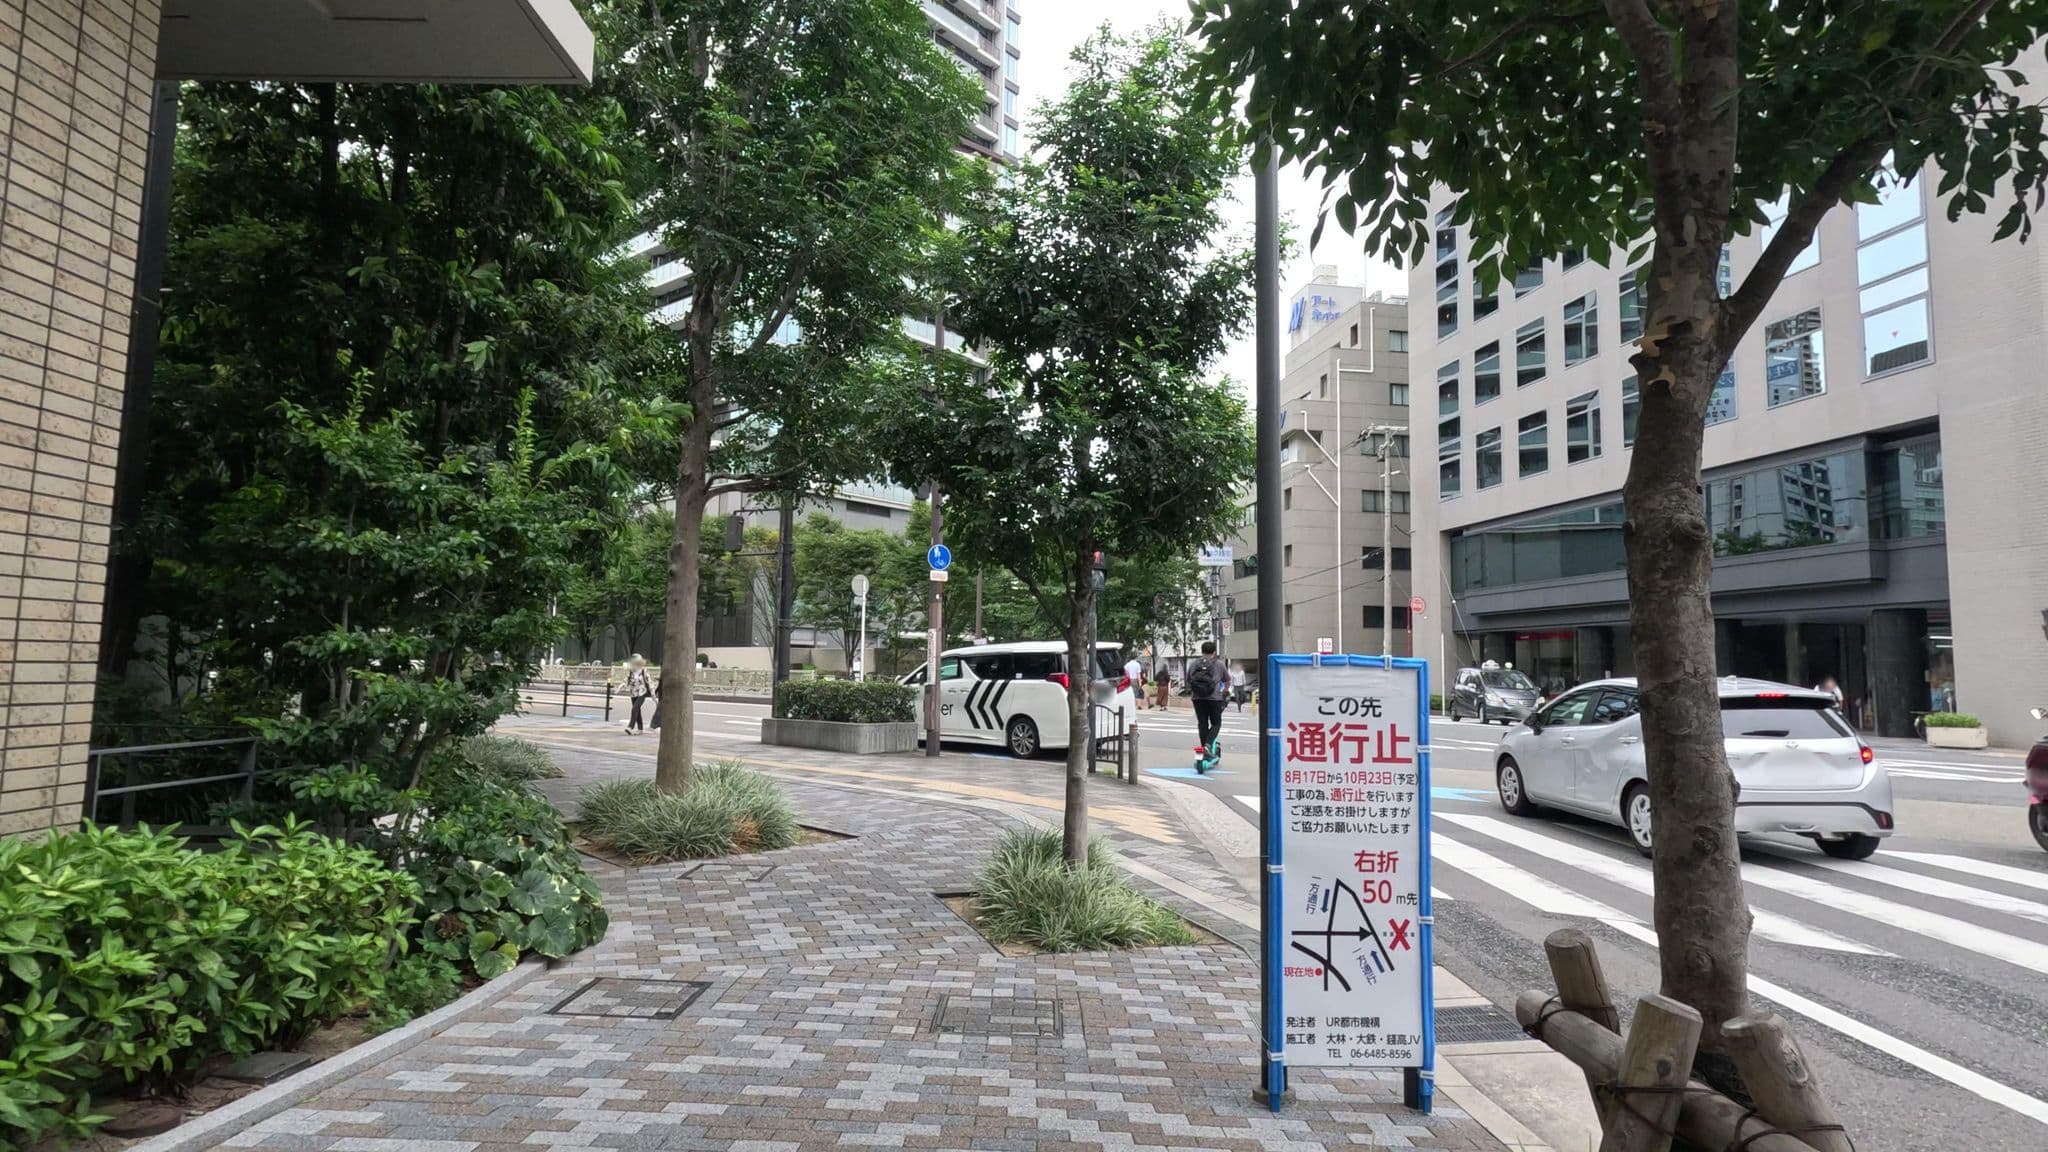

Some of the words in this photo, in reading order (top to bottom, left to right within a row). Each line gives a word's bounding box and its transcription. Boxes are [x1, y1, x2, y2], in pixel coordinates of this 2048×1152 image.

[1318, 697, 1382, 717] この先
[1286, 721, 1413, 764] 通行止
[1284, 770, 1418, 786] 8月17日から10月23日(予定)
[1291, 805, 1411, 818] ご迷惑をお掛けしますが
[1291, 821, 1411, 834] ご協力お願いいたします
[1354, 849, 1399, 873] 右折
[1363, 880, 1392, 904] 50
[1396, 892, 1418, 906] m先
[1284, 966, 1314, 977] 現在地
[1286, 1016, 1316, 1028] 発注者
[1326, 1016, 1380, 1028] UR都市機構
[1286, 1033, 1316, 1045] 施工者
[1327, 1049, 1342, 1058] TEL
[1350, 1049, 1412, 1059] 06-6485-8596
